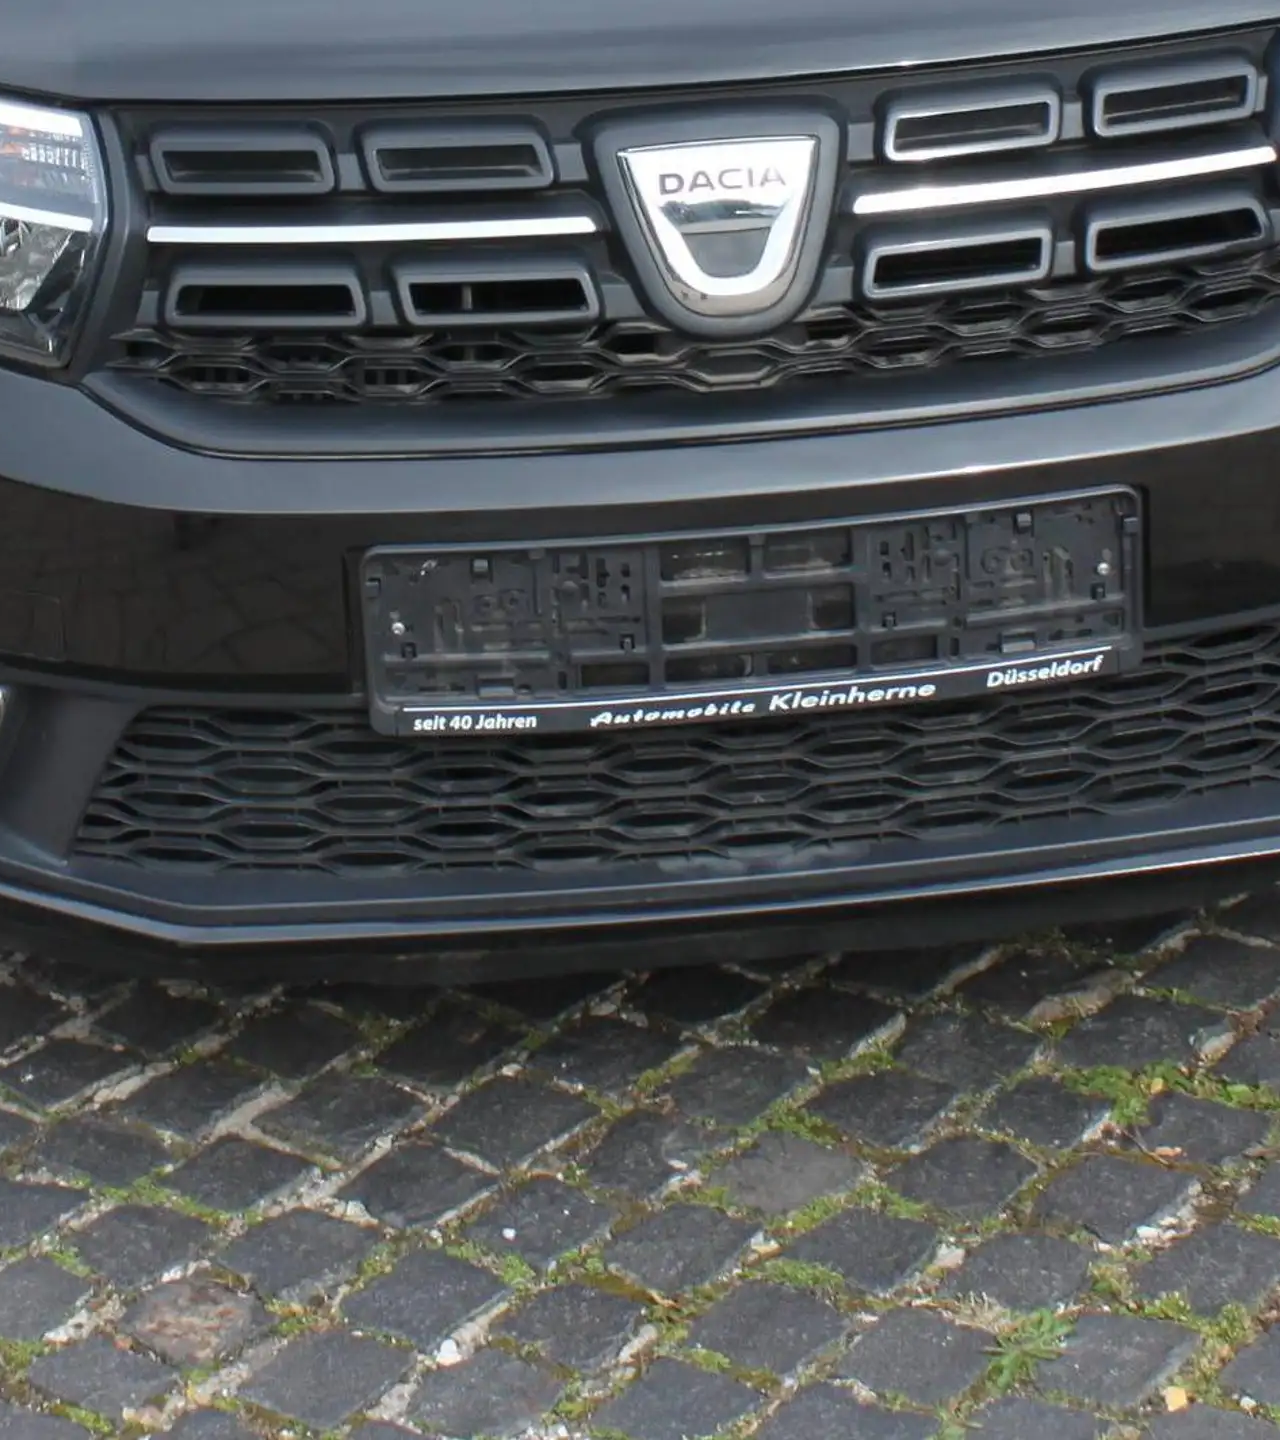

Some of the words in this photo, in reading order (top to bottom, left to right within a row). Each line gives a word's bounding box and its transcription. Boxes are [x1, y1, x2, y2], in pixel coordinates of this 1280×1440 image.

[658, 167, 787, 196] DACIA
[413, 716, 447, 732] seit
[449, 715, 472, 731] 40
[474, 713, 538, 731] Jahren
[589, 700, 756, 728] Automobile
[768, 682, 937, 712] Kleinherne
[986, 654, 1104, 689] Düsseldorf
